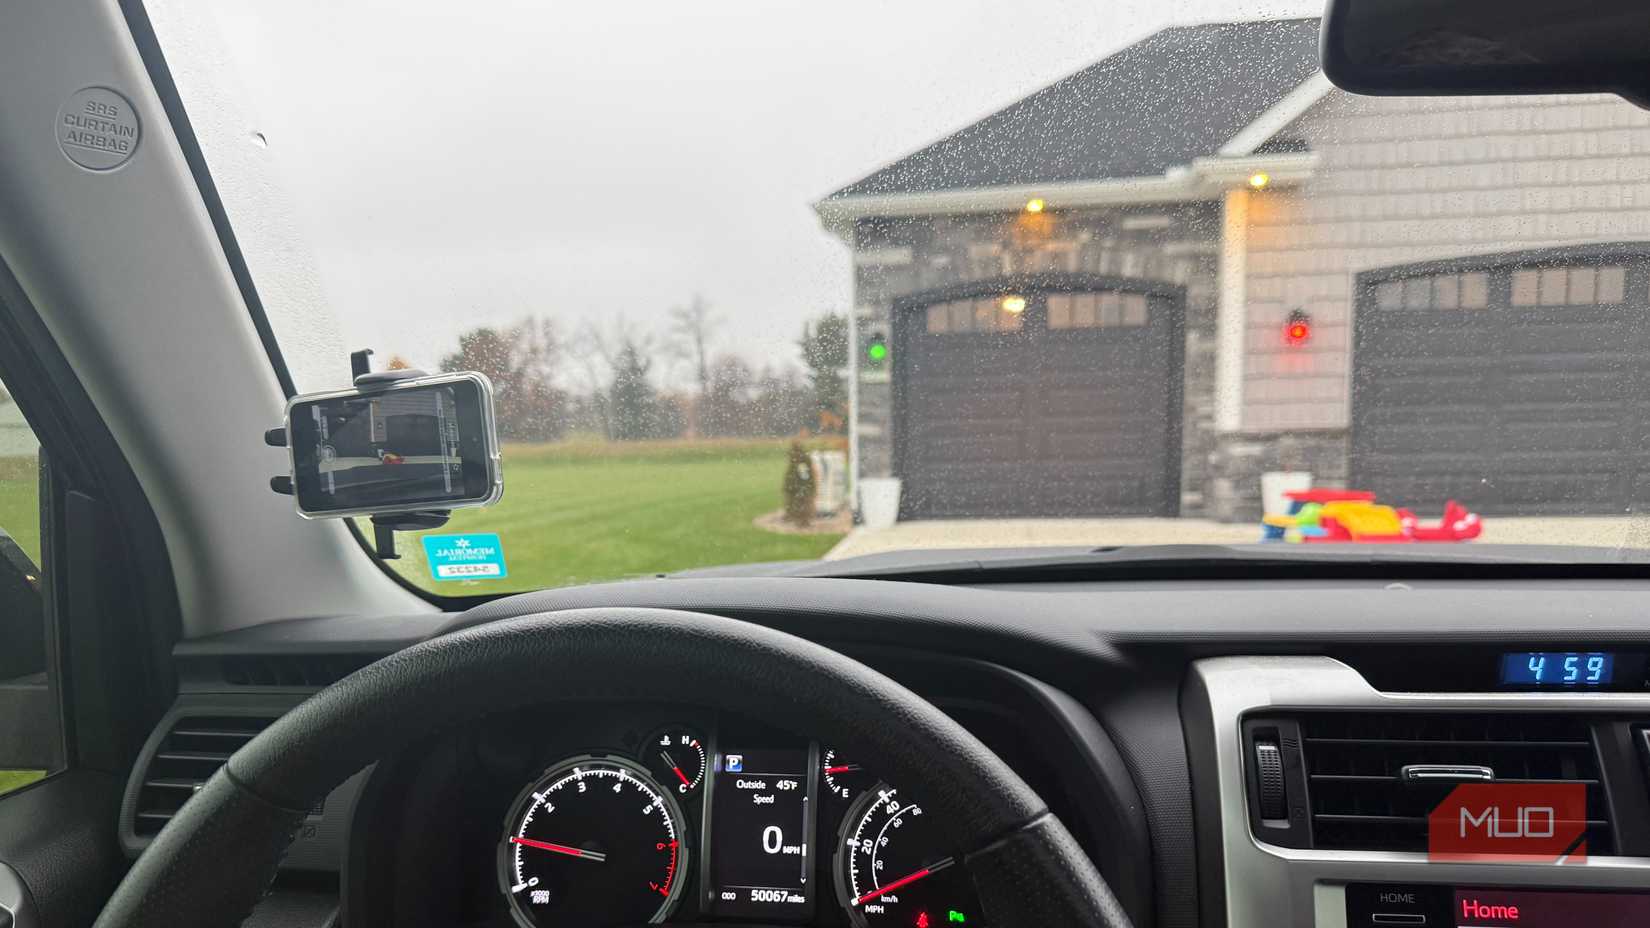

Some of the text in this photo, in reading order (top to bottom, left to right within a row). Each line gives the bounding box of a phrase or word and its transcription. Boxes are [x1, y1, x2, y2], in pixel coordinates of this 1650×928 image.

[85, 100, 119, 116] SRS
[63, 113, 135, 138] CURTAIN
[67, 130, 129, 152] AIRBAG
[682, 736, 690, 745] H
[577, 782, 587, 793] 3
[613, 782, 622, 793] 4
[679, 784, 687, 793] C
[736, 780, 766, 789] Outside
[842, 789, 849, 798] E
[753, 794, 775, 805] Speed
[544, 803, 555, 813] 2
[643, 805, 653, 815] 5
[885, 801, 900, 815] 40
[912, 808, 922, 816] 80
[893, 818, 903, 828] 60
[763, 826, 800, 854] 0 MPH
[880, 836, 889, 847] 40
[656, 842, 666, 850] 6
[861, 839, 873, 855] 20
[876, 860, 884, 870] 20
[528, 877, 539, 886] 0
[649, 881, 659, 891] 7
[533, 895, 549, 904] RPM
[751, 889, 788, 902] 50067
[787, 895, 805, 903] miles
[880, 895, 898, 903] km/h
[1380, 893, 1416, 904] HOME
[865, 905, 885, 914] MPH
[1462, 899, 1519, 919] Home
